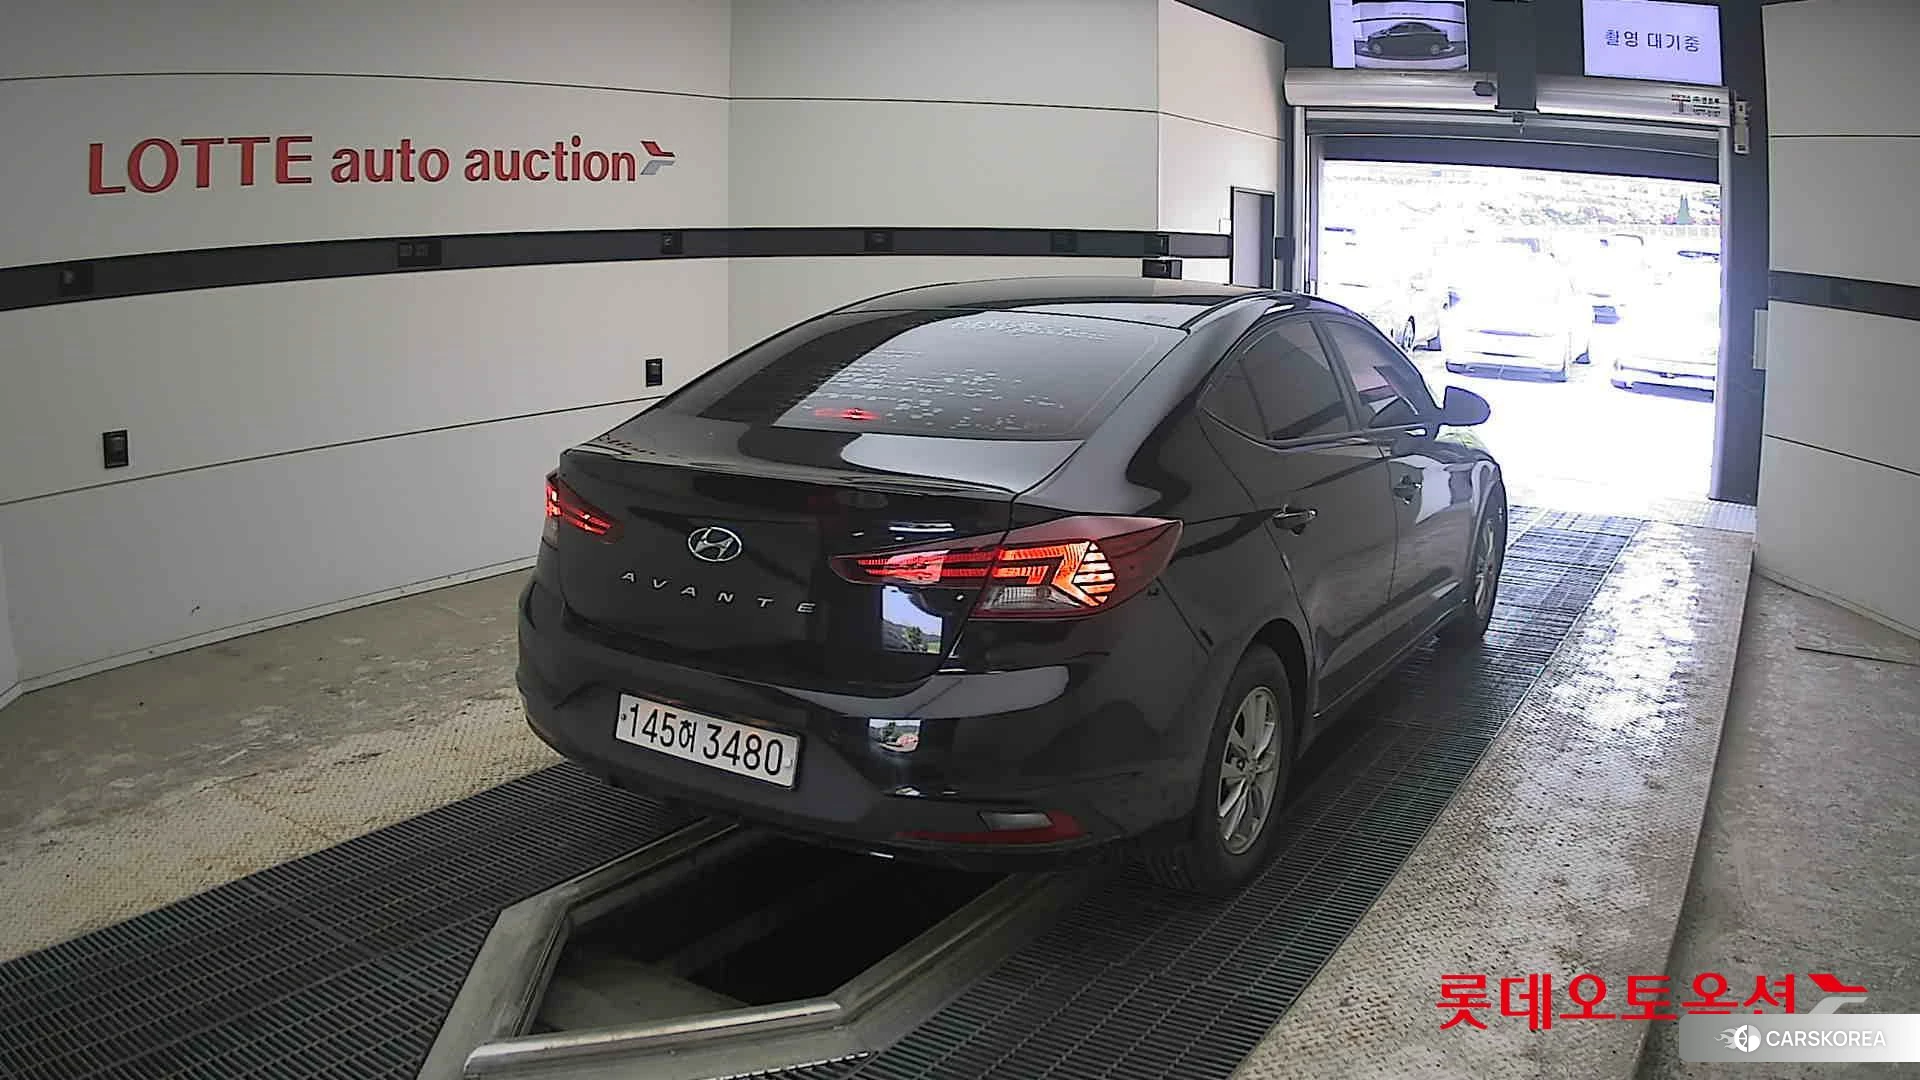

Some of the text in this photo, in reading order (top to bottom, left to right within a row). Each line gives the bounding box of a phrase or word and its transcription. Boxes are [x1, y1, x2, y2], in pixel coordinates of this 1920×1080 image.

[1647, 32, 1700, 52] 대기중
[88, 135, 637, 195] LOTTE auto auction
[621, 571, 816, 614] AVANTE
[629, 703, 784, 776] 145허 3480
